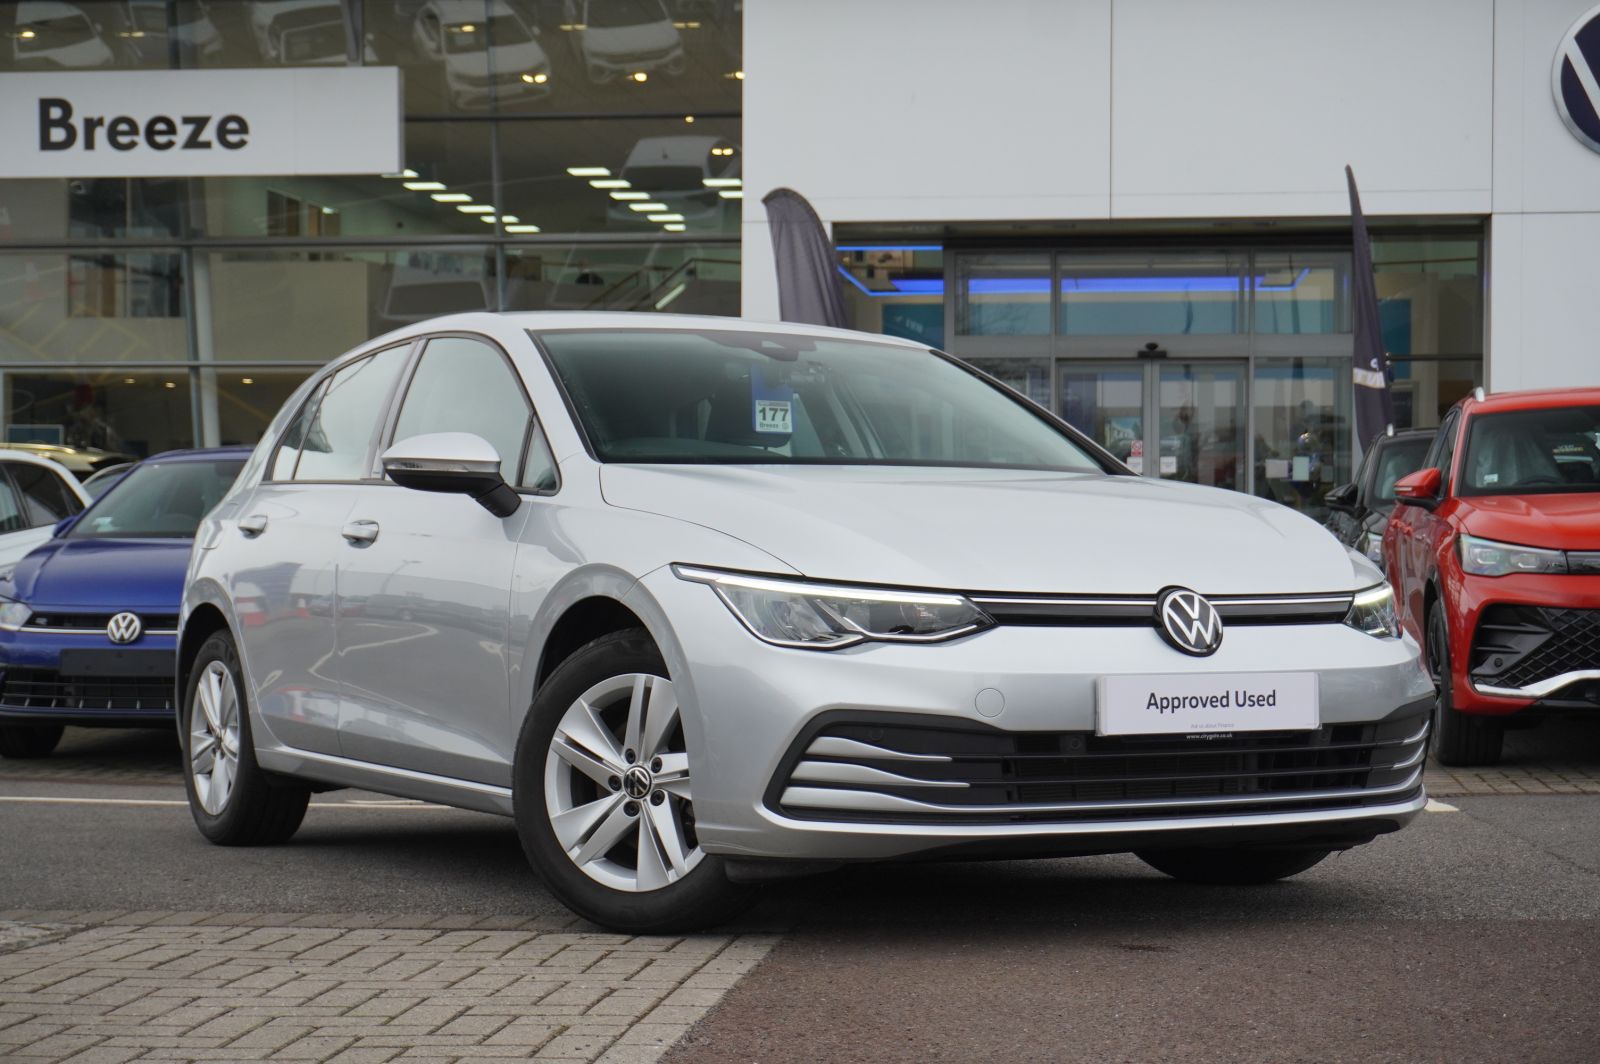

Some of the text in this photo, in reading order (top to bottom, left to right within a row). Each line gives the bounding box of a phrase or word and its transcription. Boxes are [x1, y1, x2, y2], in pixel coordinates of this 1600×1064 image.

[38, 97, 250, 151] Breeze
[759, 407, 789, 421] 177
[1146, 689, 1276, 714] Approved Used
